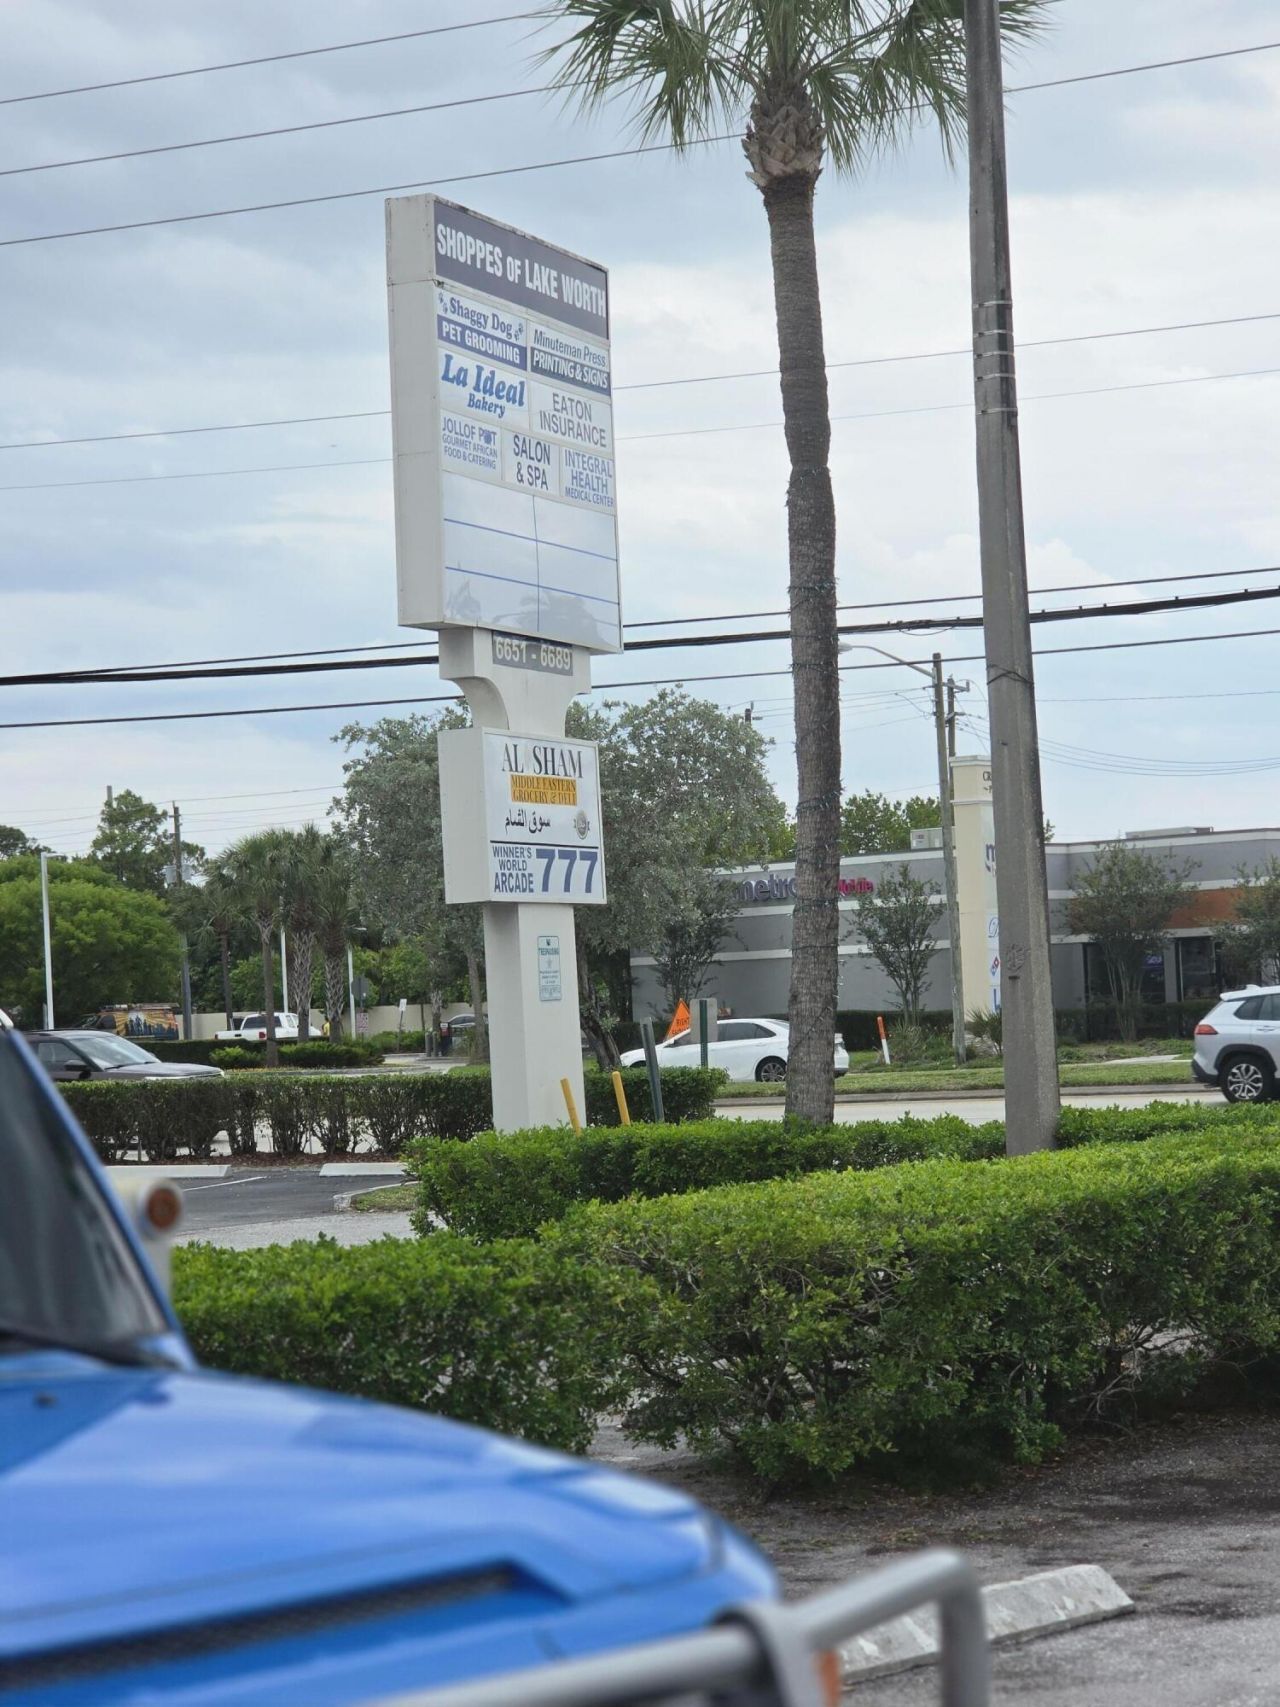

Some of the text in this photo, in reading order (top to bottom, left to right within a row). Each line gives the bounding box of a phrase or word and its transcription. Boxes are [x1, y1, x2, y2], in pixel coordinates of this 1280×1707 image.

[437, 224, 606, 317] SHOPPES OF LAKE WORTH
[449, 297, 513, 339] Shaggy Dog
[442, 322, 520, 363] PET GROOMING
[534, 330, 606, 367] Minuteman Press
[441, 354, 525, 407] La Ideal
[533, 352, 574, 377] PRINTING
[583, 366, 608, 389] SIGNS
[467, 393, 505, 418] Bakery
[553, 393, 592, 422] EATON
[443, 417, 476, 440] JOLLOF
[540, 411, 607, 447] INSURANCE
[443, 435, 498, 458] GOURMET AFRICAN
[444, 446, 462, 460] FOOD
[467, 453, 496, 469] CATERING
[513, 435, 551, 465] SALON
[516, 461, 549, 490] & SPA
[565, 450, 613, 478] INTEGRAL
[571, 470, 608, 494] HEALTH
[565, 487, 614, 507] MEDICAL CENTER
[496, 637, 526, 663] 6651
[540, 645, 571, 670] 6689
[502, 743, 583, 778] AL SHAM
[511, 775, 577, 792] MIDDLE EASTERN
[513, 790, 549, 803] GROCERY
[505, 809, 551, 835] سوق الشام
[492, 846, 532, 859] WINNER'S
[498, 858, 528, 871] WORLD
[494, 872, 534, 893] ARCADE
[535, 848, 598, 894] 777
